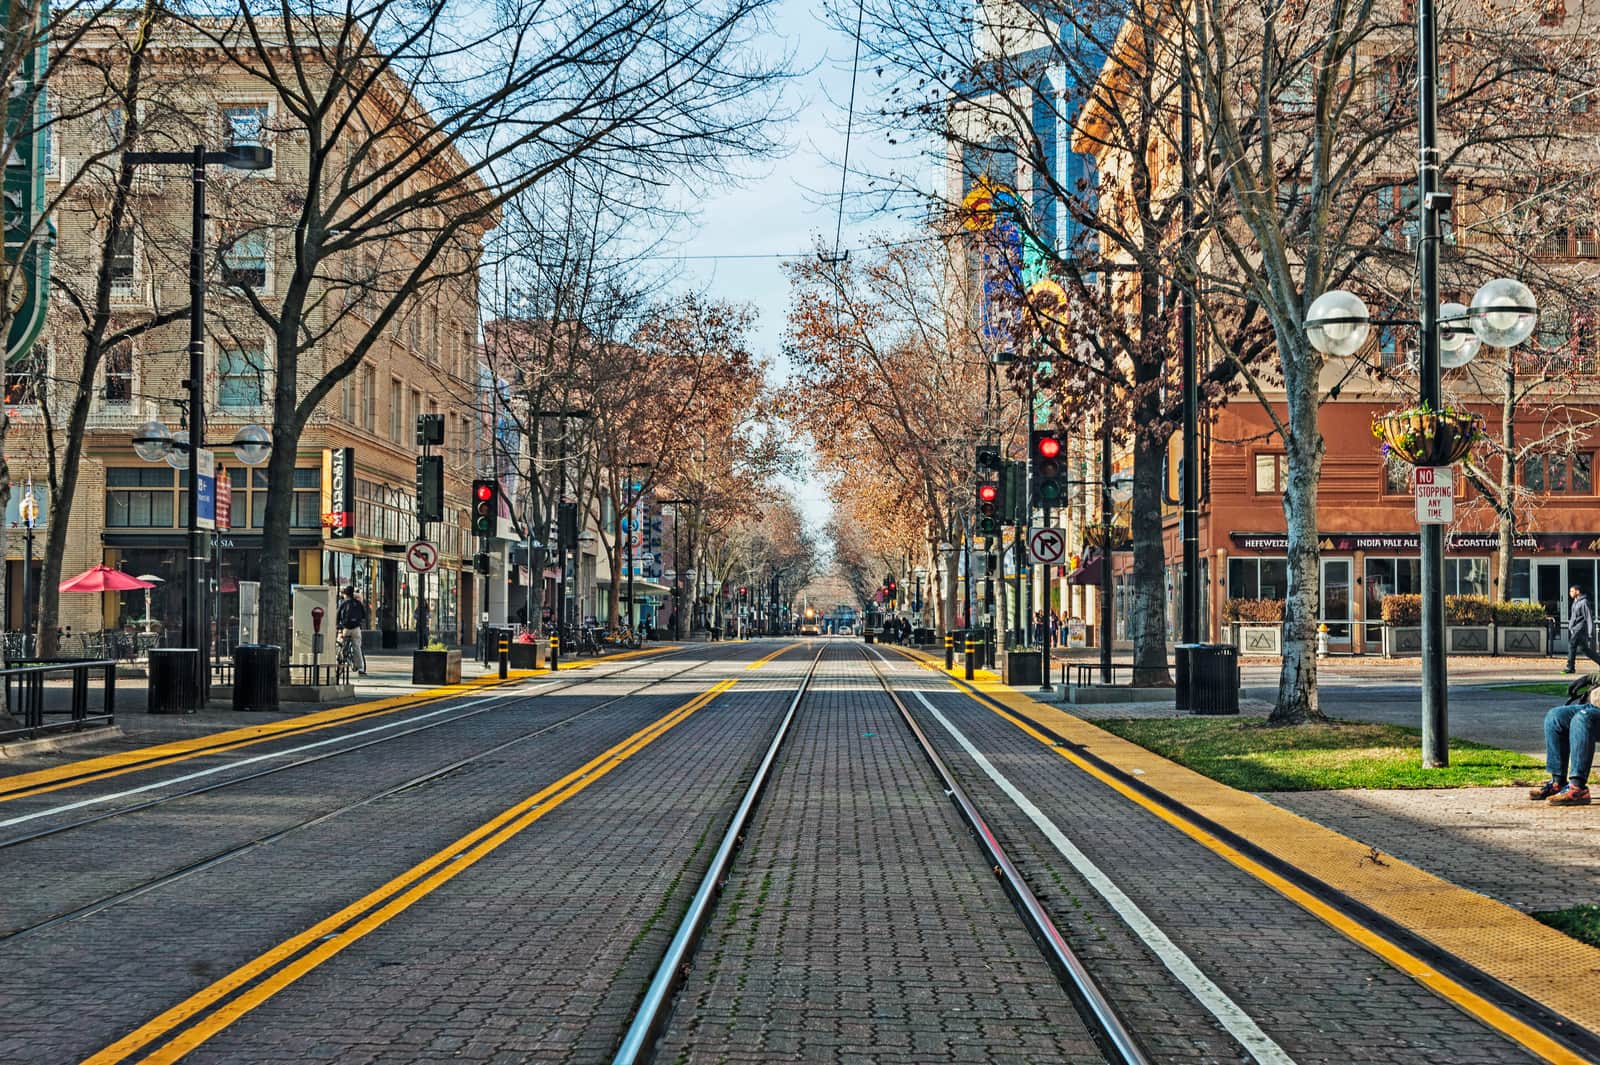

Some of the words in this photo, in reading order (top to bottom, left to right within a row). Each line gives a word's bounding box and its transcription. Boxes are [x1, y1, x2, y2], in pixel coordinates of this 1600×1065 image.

[1419, 470, 1433, 483] NO
[332, 448, 344, 537] AMBROSIA
[1418, 486, 1452, 498] STOPPING
[1428, 499, 1441, 508] ANY
[1428, 508, 1442, 518] TIME
[1245, 539, 1289, 548] HEFEWEIZE
[1357, 538, 1381, 548] INDIA
[1383, 538, 1402, 548] PALE
[1403, 538, 1419, 548] ALE
